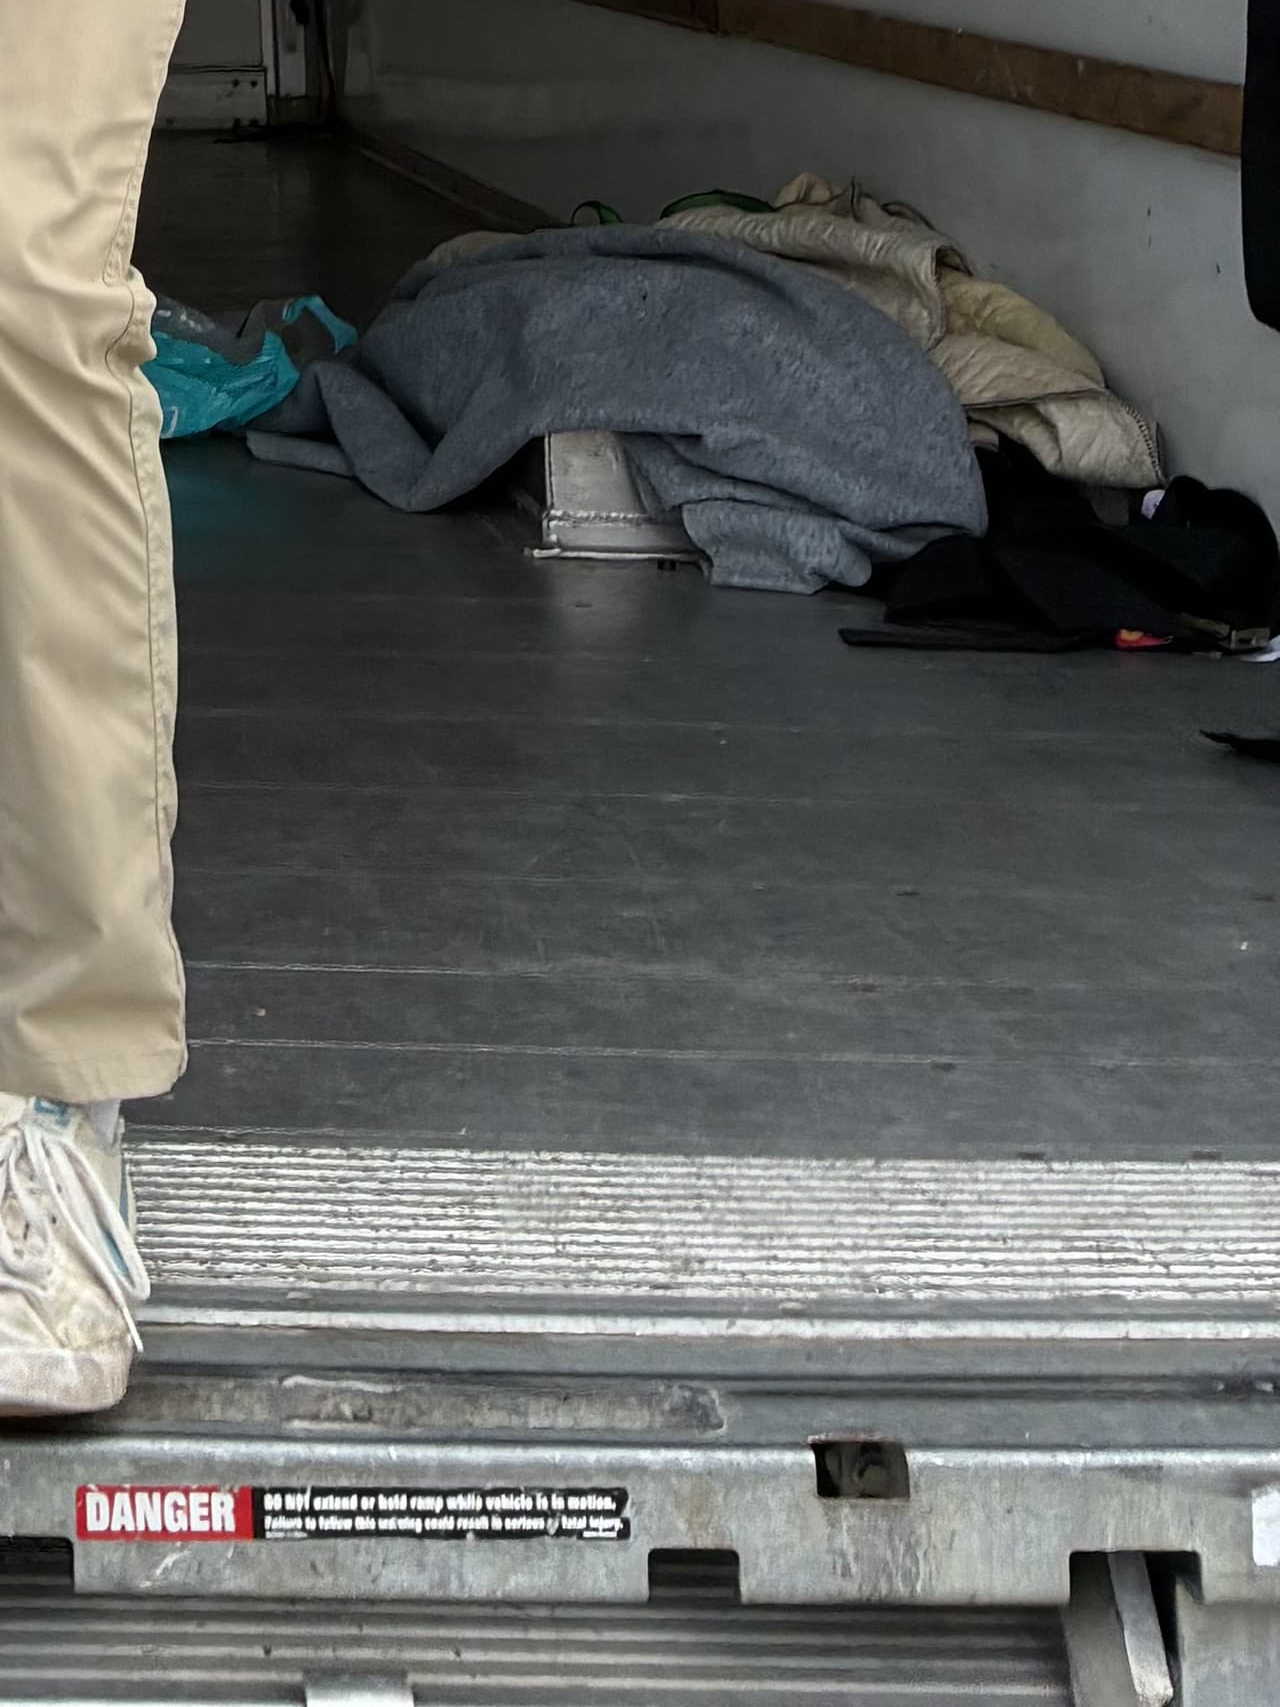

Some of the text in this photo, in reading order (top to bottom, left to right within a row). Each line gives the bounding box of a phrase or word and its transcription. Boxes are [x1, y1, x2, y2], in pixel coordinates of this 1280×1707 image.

[85, 1491, 236, 1532] DANGER
[264, 1493, 282, 1511] DO
[284, 1493, 310, 1512] NOT
[313, 1494, 358, 1511] extend
[360, 1496, 375, 1511] or
[378, 1493, 407, 1511] hold
[410, 1494, 443, 1513] ramp
[446, 1493, 482, 1511] while
[485, 1493, 533, 1511] vehicle
[551, 1493, 565, 1511] in
[304, 1516, 317, 1531] to
